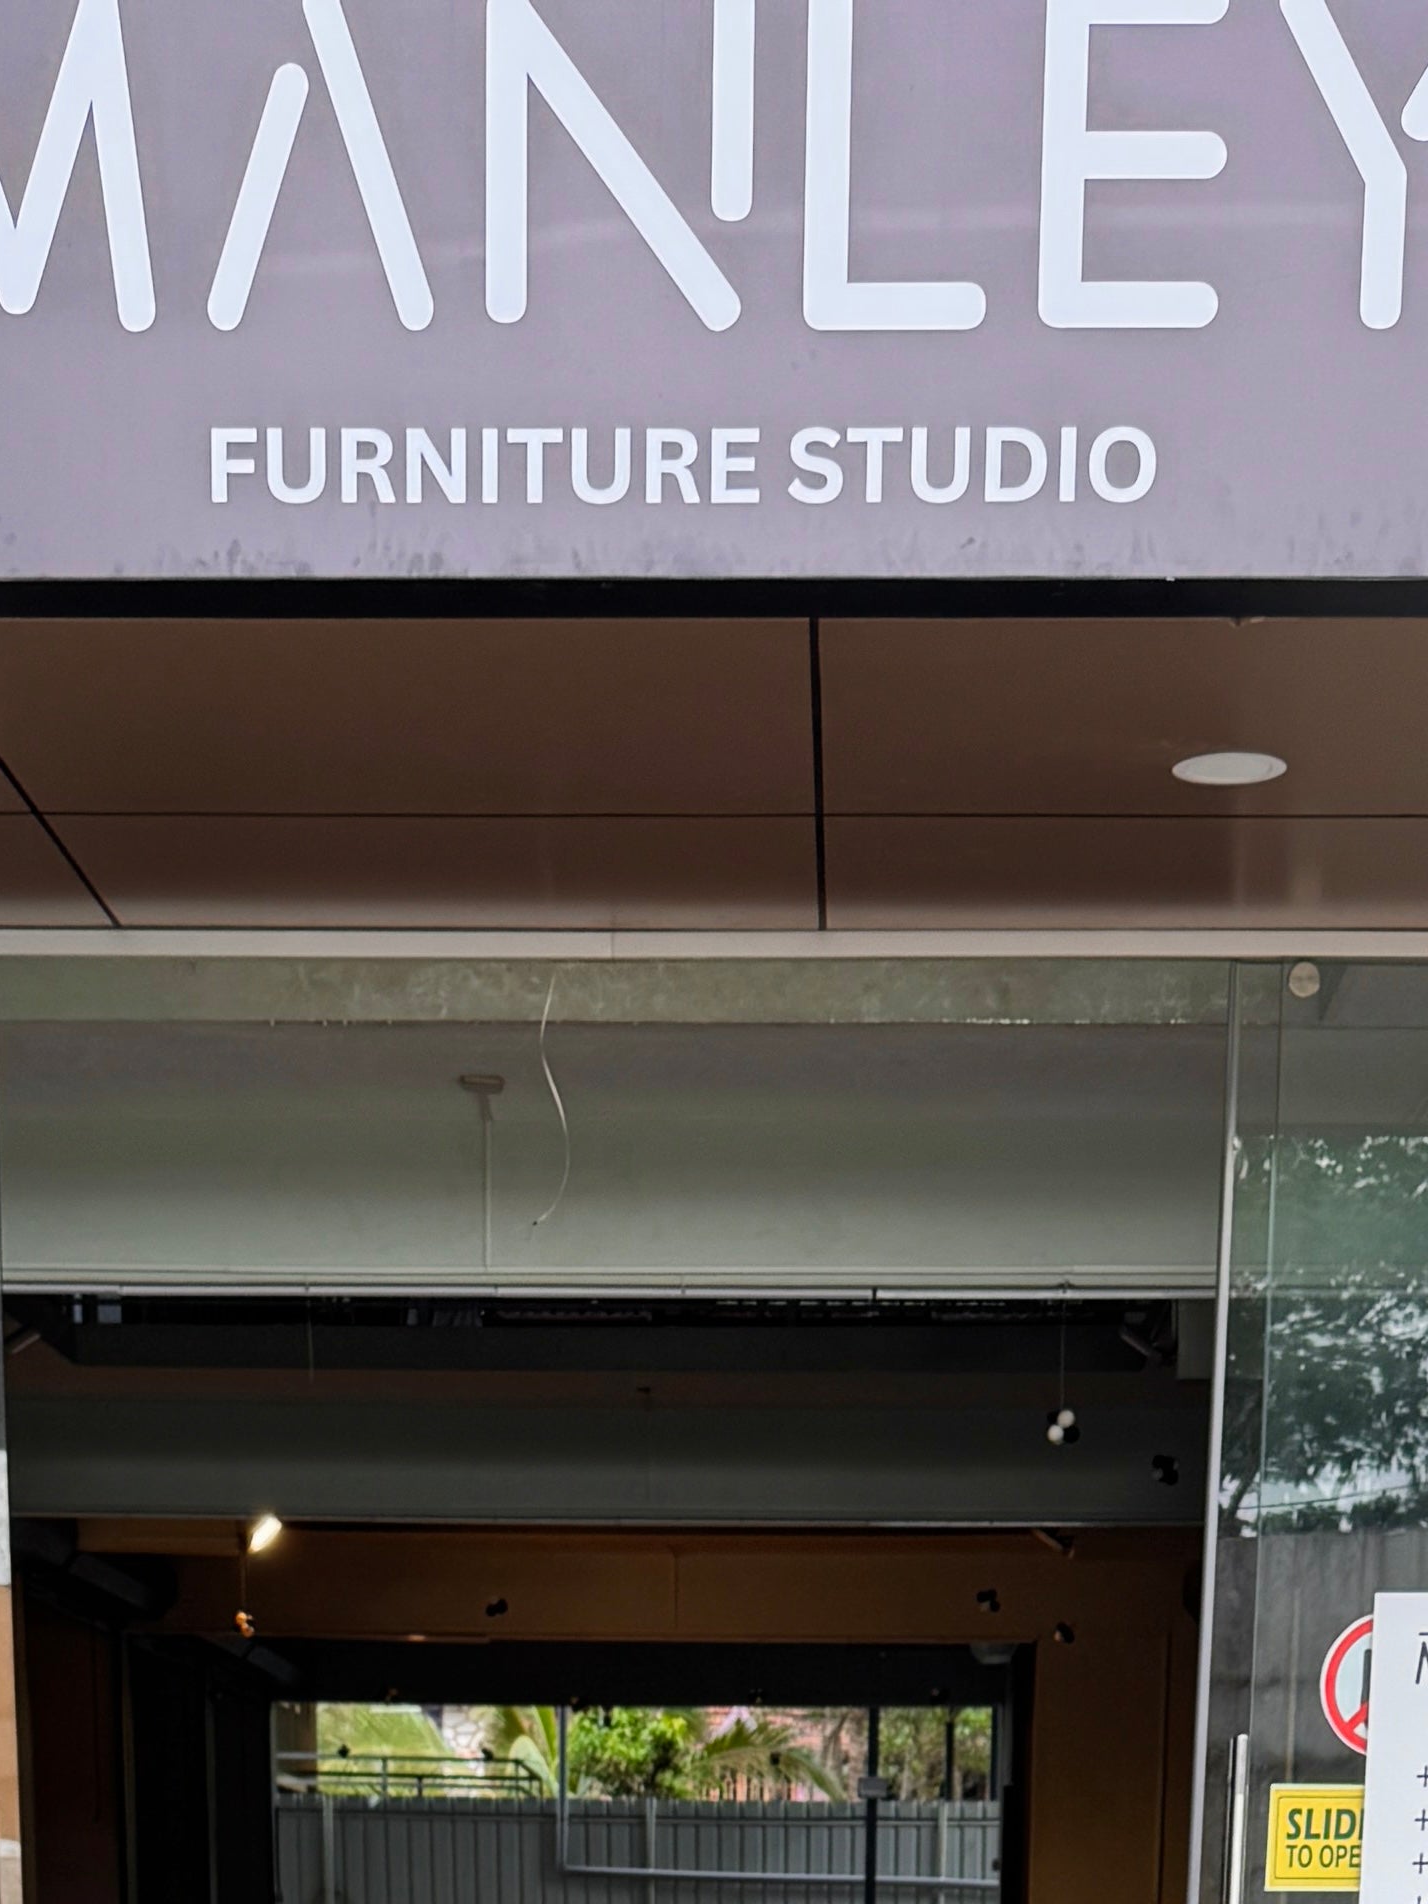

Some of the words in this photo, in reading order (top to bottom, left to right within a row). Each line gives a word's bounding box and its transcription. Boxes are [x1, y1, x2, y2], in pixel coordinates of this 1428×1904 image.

[210, 427, 760, 504] FURNITURE
[787, 425, 1157, 504] STUDIO
[1286, 1808, 1365, 1840] SLID
[1285, 1844, 1313, 1868] TO
[1319, 1844, 1362, 1868] OPE
